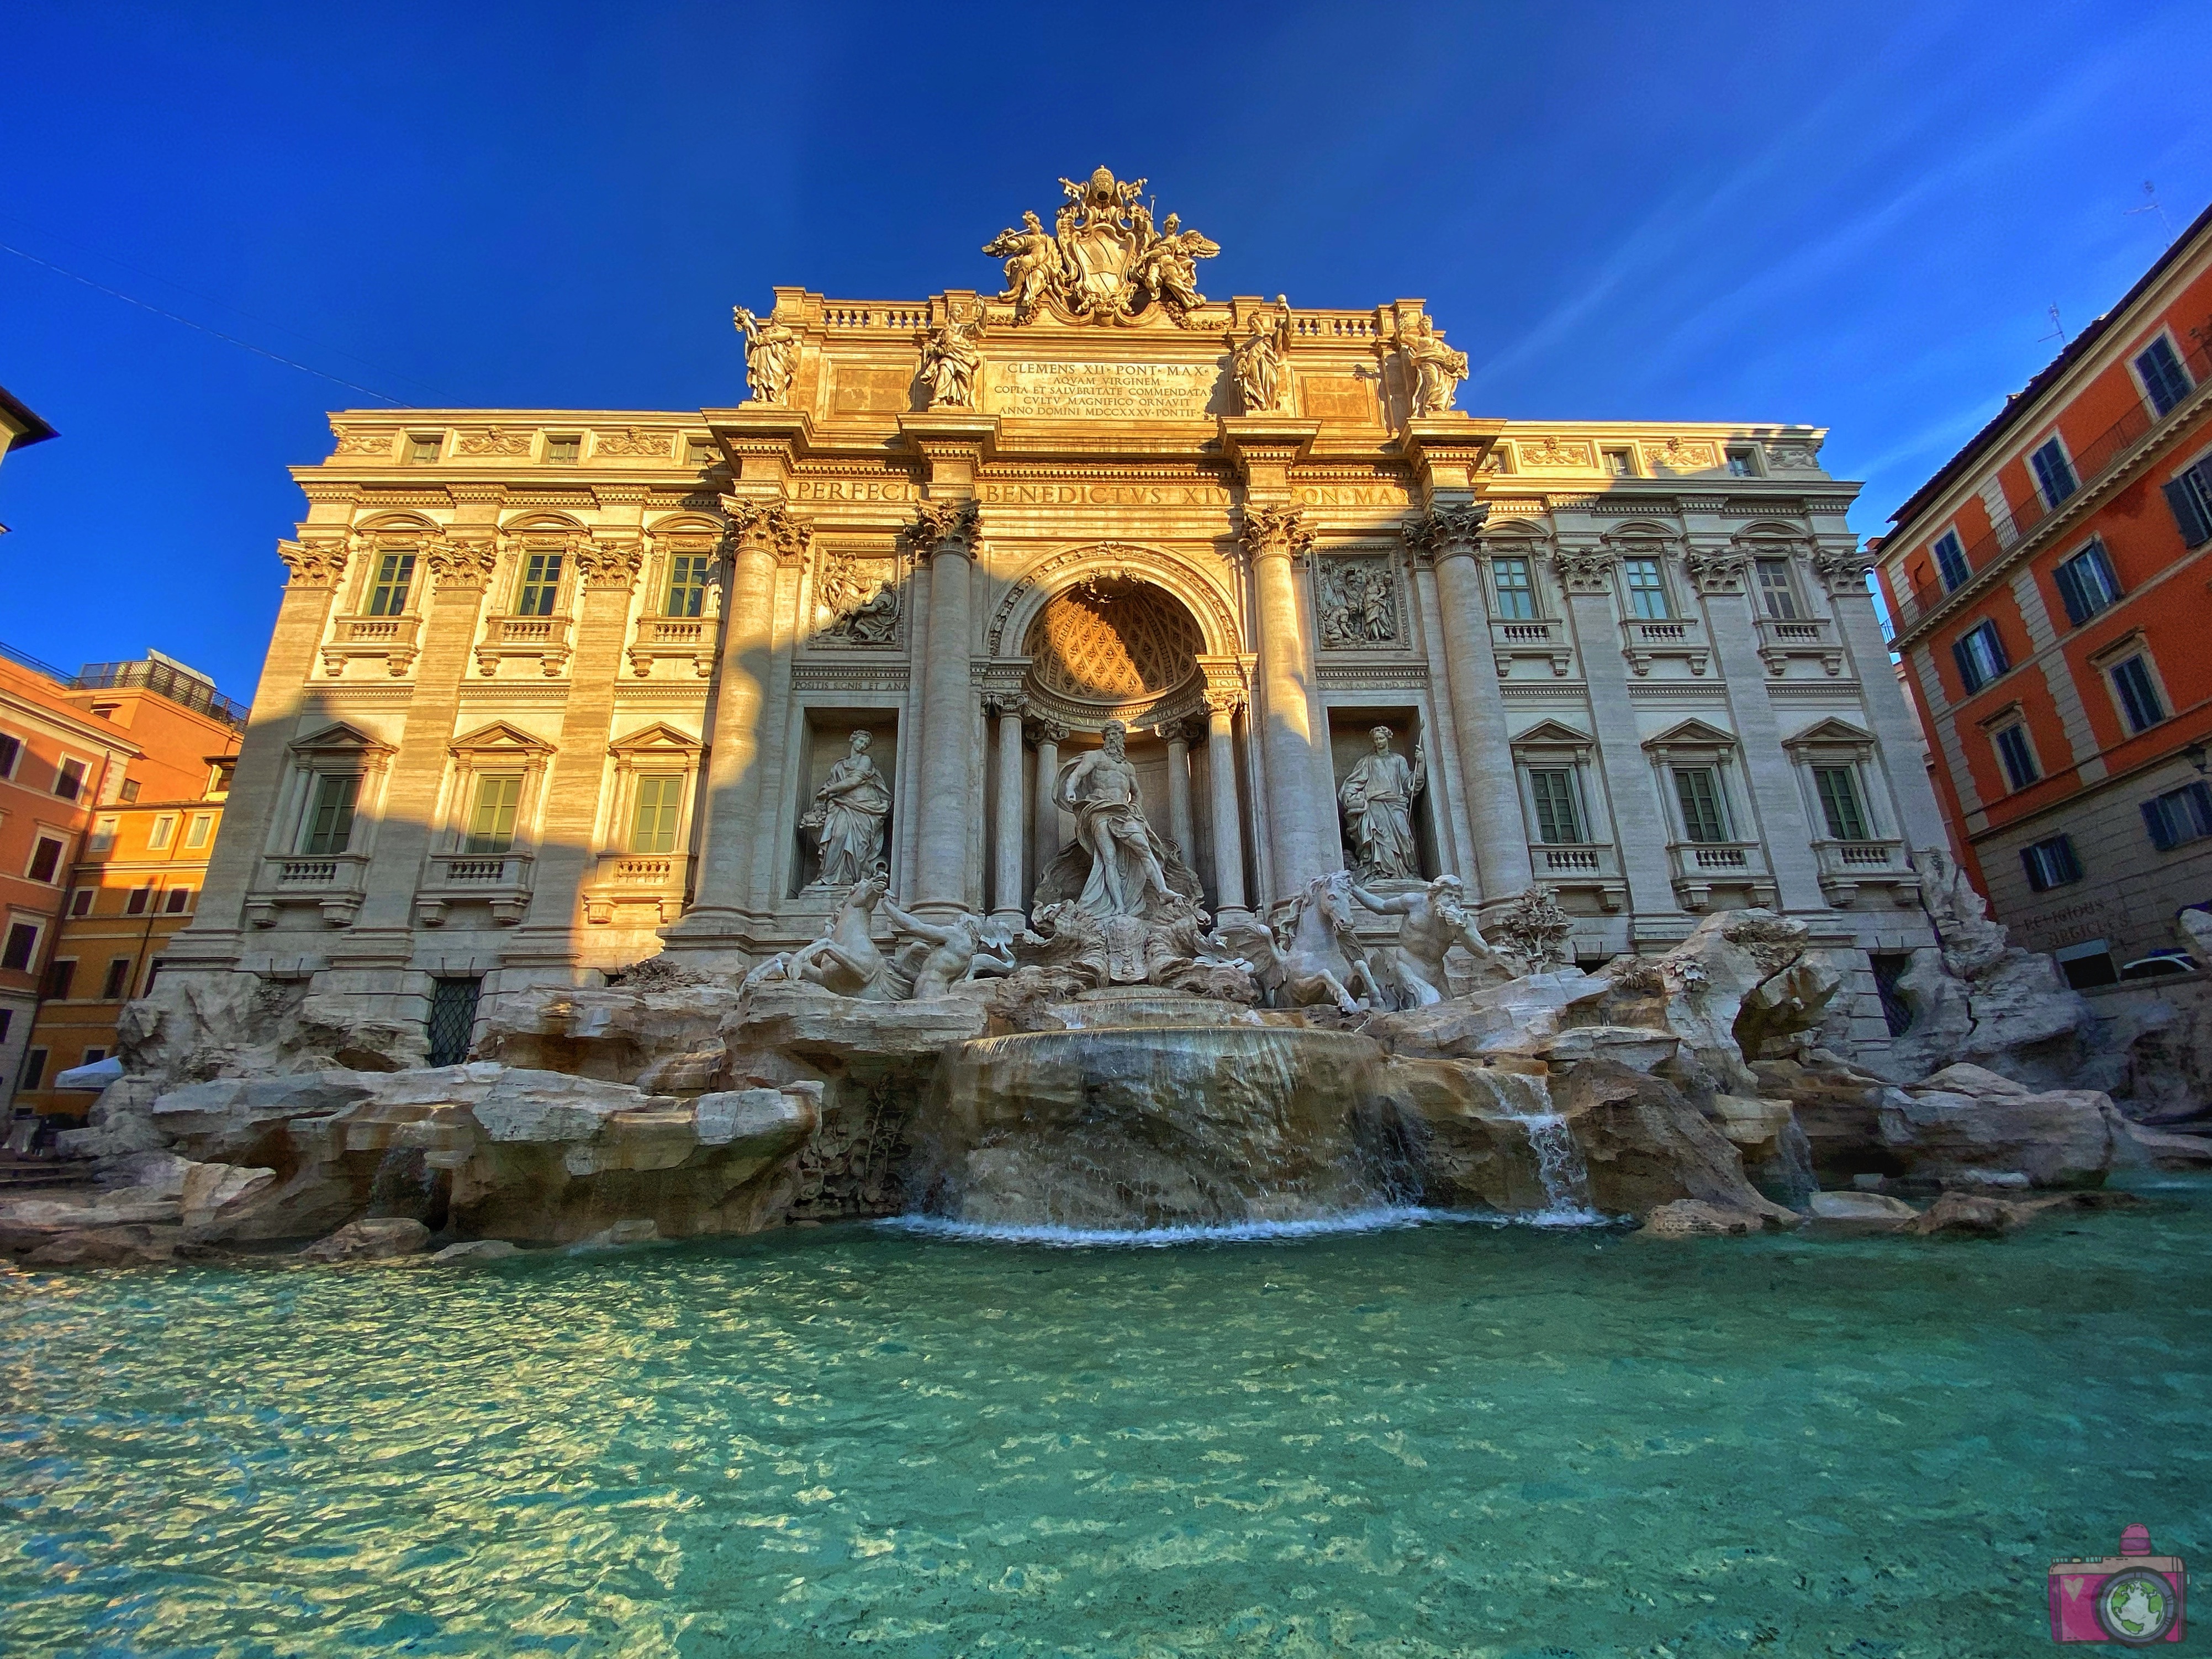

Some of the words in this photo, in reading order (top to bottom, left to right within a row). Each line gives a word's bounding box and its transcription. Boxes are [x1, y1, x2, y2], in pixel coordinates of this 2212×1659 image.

[1007, 363, 1075, 374] CLEMENS
[1053, 377, 1095, 386] AQVAM
[1102, 377, 1160, 385] VIRGINEM
[1050, 387, 1122, 395] SALVBRITATE
[1128, 388, 1218, 397] COMMENDATAM
[1068, 397, 1133, 405] MAGNIFICO
[1139, 398, 1191, 406] ORNAVIT
[999, 406, 1033, 415] ANNO
[1038, 407, 1080, 415] DOMINI
[985, 485, 1161, 504] BENEDICTVS
[1182, 488, 1230, 504] XIV
[795, 681, 828, 690] POSITIS
